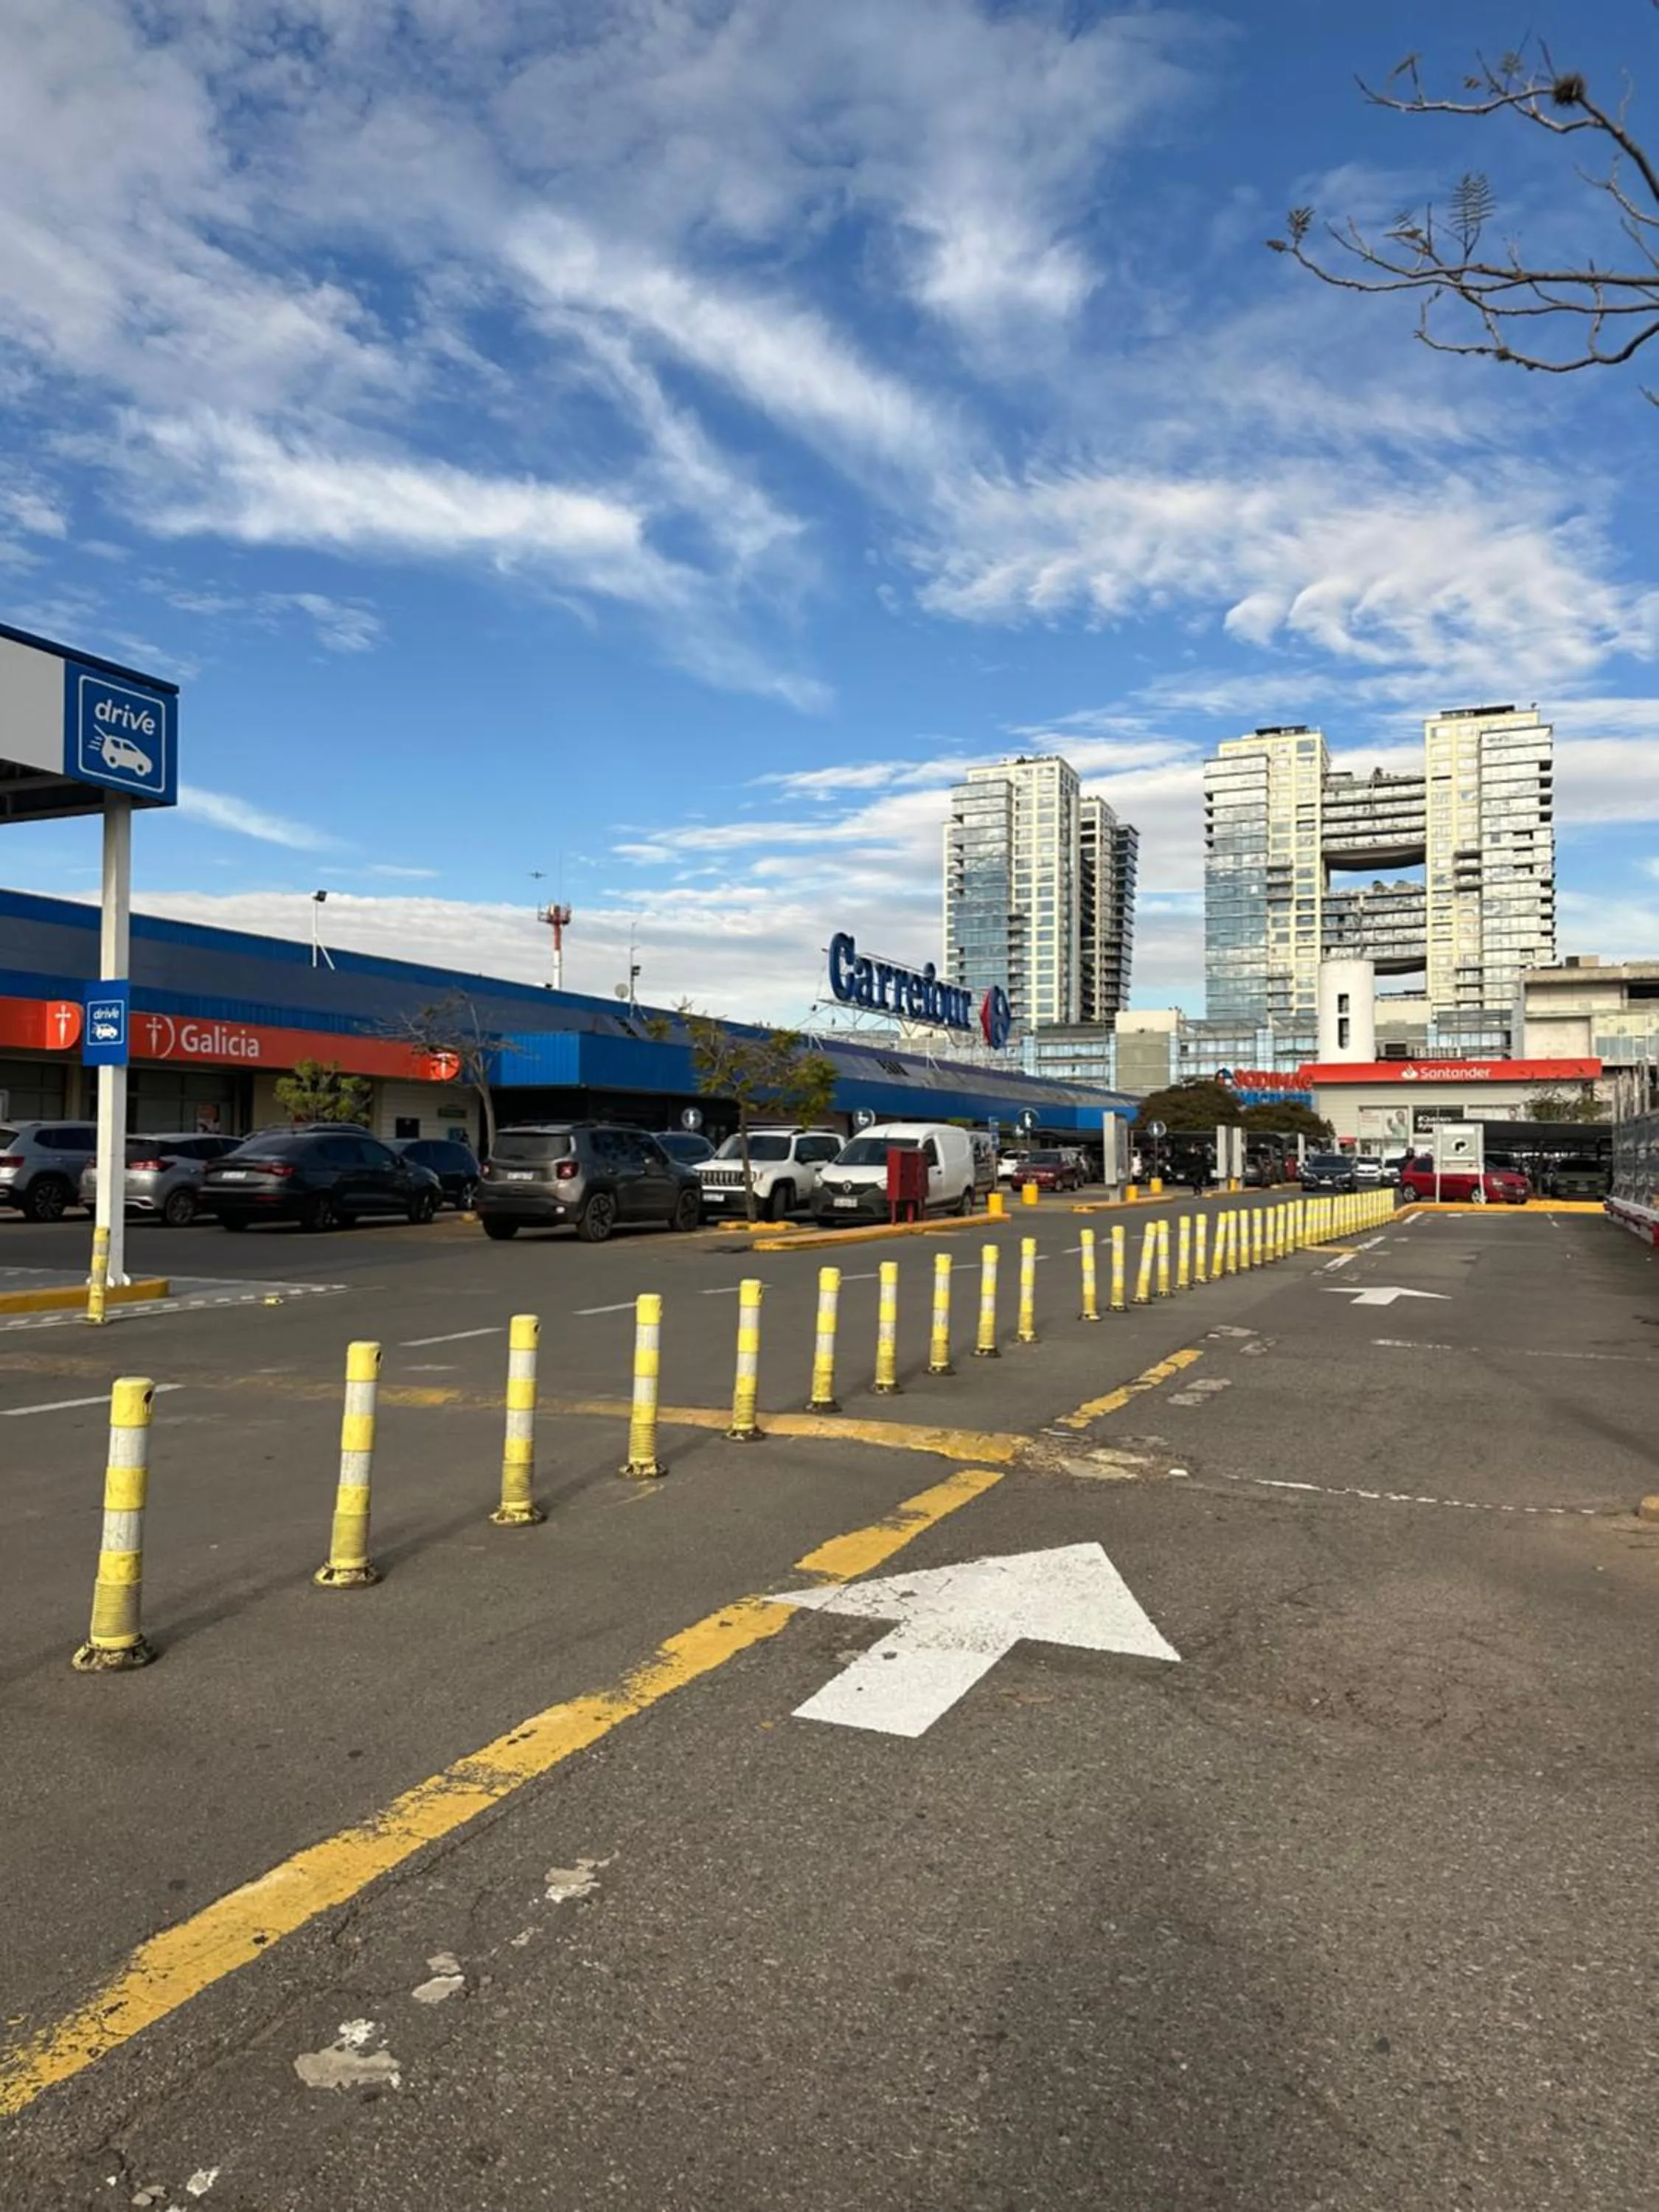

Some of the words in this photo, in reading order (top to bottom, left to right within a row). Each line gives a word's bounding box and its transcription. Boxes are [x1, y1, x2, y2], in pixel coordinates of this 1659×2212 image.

[94, 699, 156, 735] drive
[829, 931, 972, 1031] Carrefour
[93, 1006, 119, 1020] drive
[180, 1024, 260, 1058] Galicia
[1420, 1066, 1492, 1080] Santander
